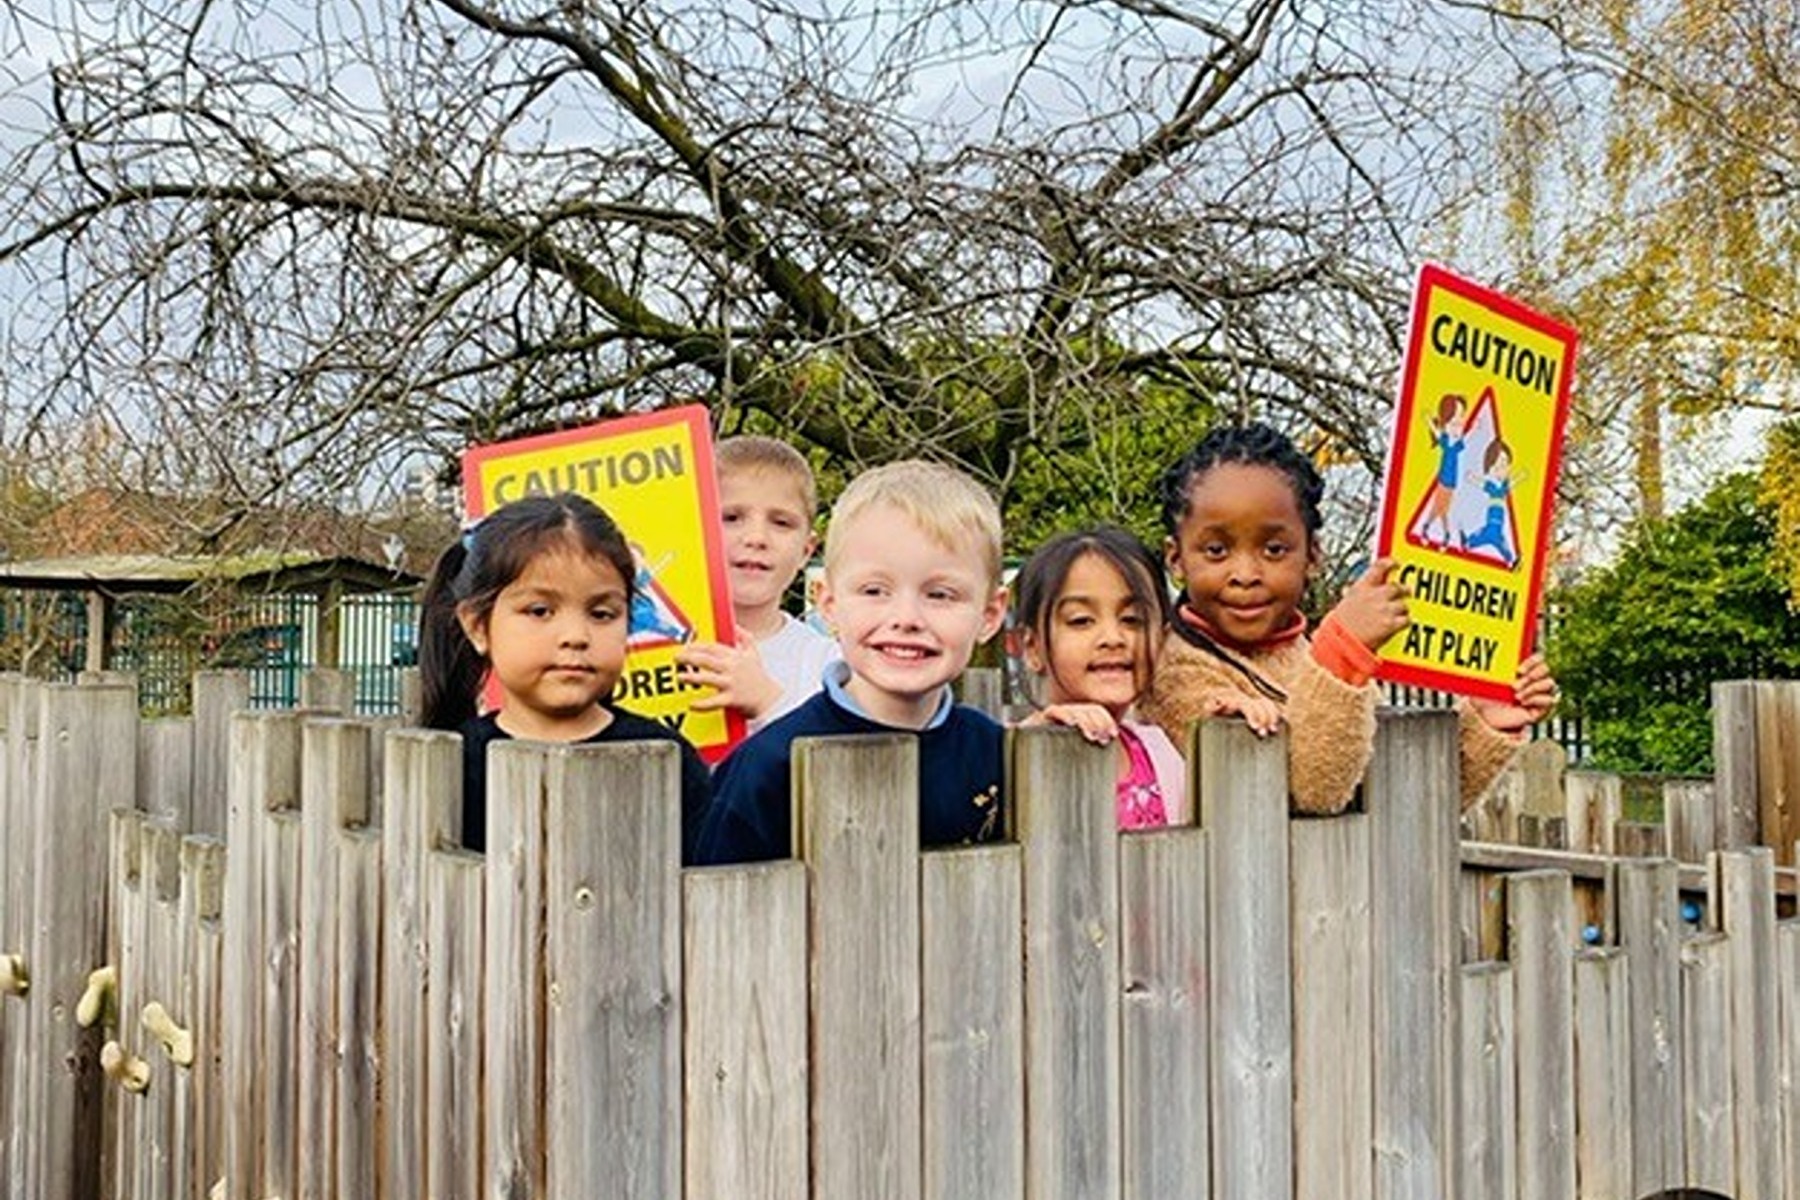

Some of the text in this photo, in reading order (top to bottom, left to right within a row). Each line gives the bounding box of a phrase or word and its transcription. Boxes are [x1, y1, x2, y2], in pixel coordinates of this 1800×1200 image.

[1431, 314, 1556, 395] CAUTION
[493, 443, 685, 504] CAUTION
[1403, 623, 1499, 672] AT PLAY
